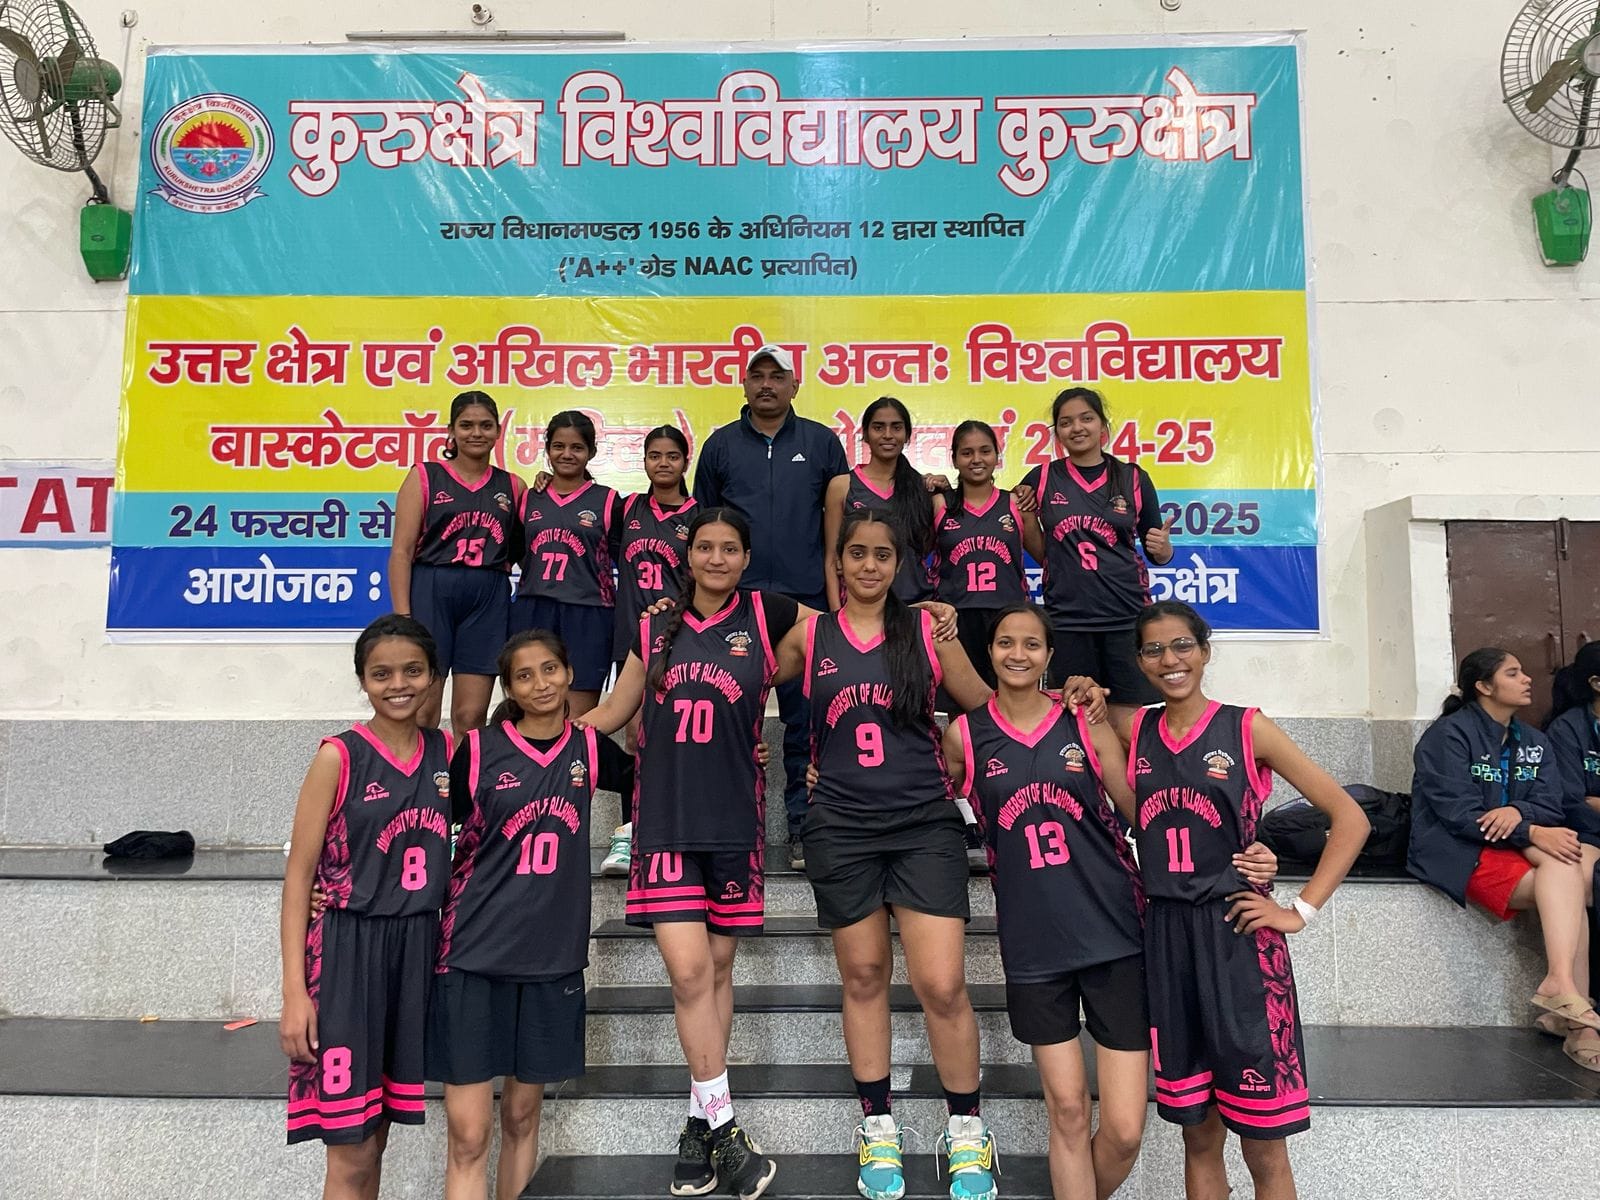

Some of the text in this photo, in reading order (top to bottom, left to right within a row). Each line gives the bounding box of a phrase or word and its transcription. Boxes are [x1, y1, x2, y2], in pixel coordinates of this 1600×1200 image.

[288, 66, 1257, 198] कुरुक्षेत्र विश्वविद्यालय कुरुक्षेत्र
[164, 166, 257, 193] KURUKSHETRA UNIVERSITY
[440, 212, 1026, 242] राज्य विधानमण्डल 1956 के अधिनियम 12 द्वारा स्थापित
[559, 252, 857, 283] ('A++' ग्रेड NAAC प्रत्यापित)
[148, 341, 258, 386] उत्तर
[266, 326, 351, 386] क्षेत्र
[362, 327, 443, 387] एवं
[446, 324, 618, 388] अखिल
[818, 342, 950, 386] अन्तः
[966, 322, 1283, 384] विश्वविद्यालय
[1025, 420, 1214, 465] 24-25
[168, 499, 1261, 539] 24 फरवरी से 2025
[1083, 515, 1092, 530] OF
[451, 537, 486, 567] 15
[976, 536, 985, 550] OF
[1077, 541, 1098, 571] 6
[183, 553, 357, 605] आयोजक
[541, 552, 569, 581] 77
[638, 561, 663, 590] 31
[966, 562, 996, 591] 12
[690, 662, 701, 681] OF
[860, 683, 871, 705] OF
[673, 699, 714, 743] 70
[855, 722, 885, 767] 9
[410, 808, 419, 830] OF
[997, 784, 1032, 831] UNIVERSITY
[1030, 782, 1041, 804] OF
[1170, 787, 1180, 809] OF
[1182, 787, 1223, 829] ALLAHABAD
[516, 832, 559, 875] 10
[1024, 821, 1071, 870] 13
[1165, 827, 1195, 872] 11
[401, 846, 427, 891] 8
[645, 851, 683, 884] 70
[322, 1046, 352, 1095] 8
